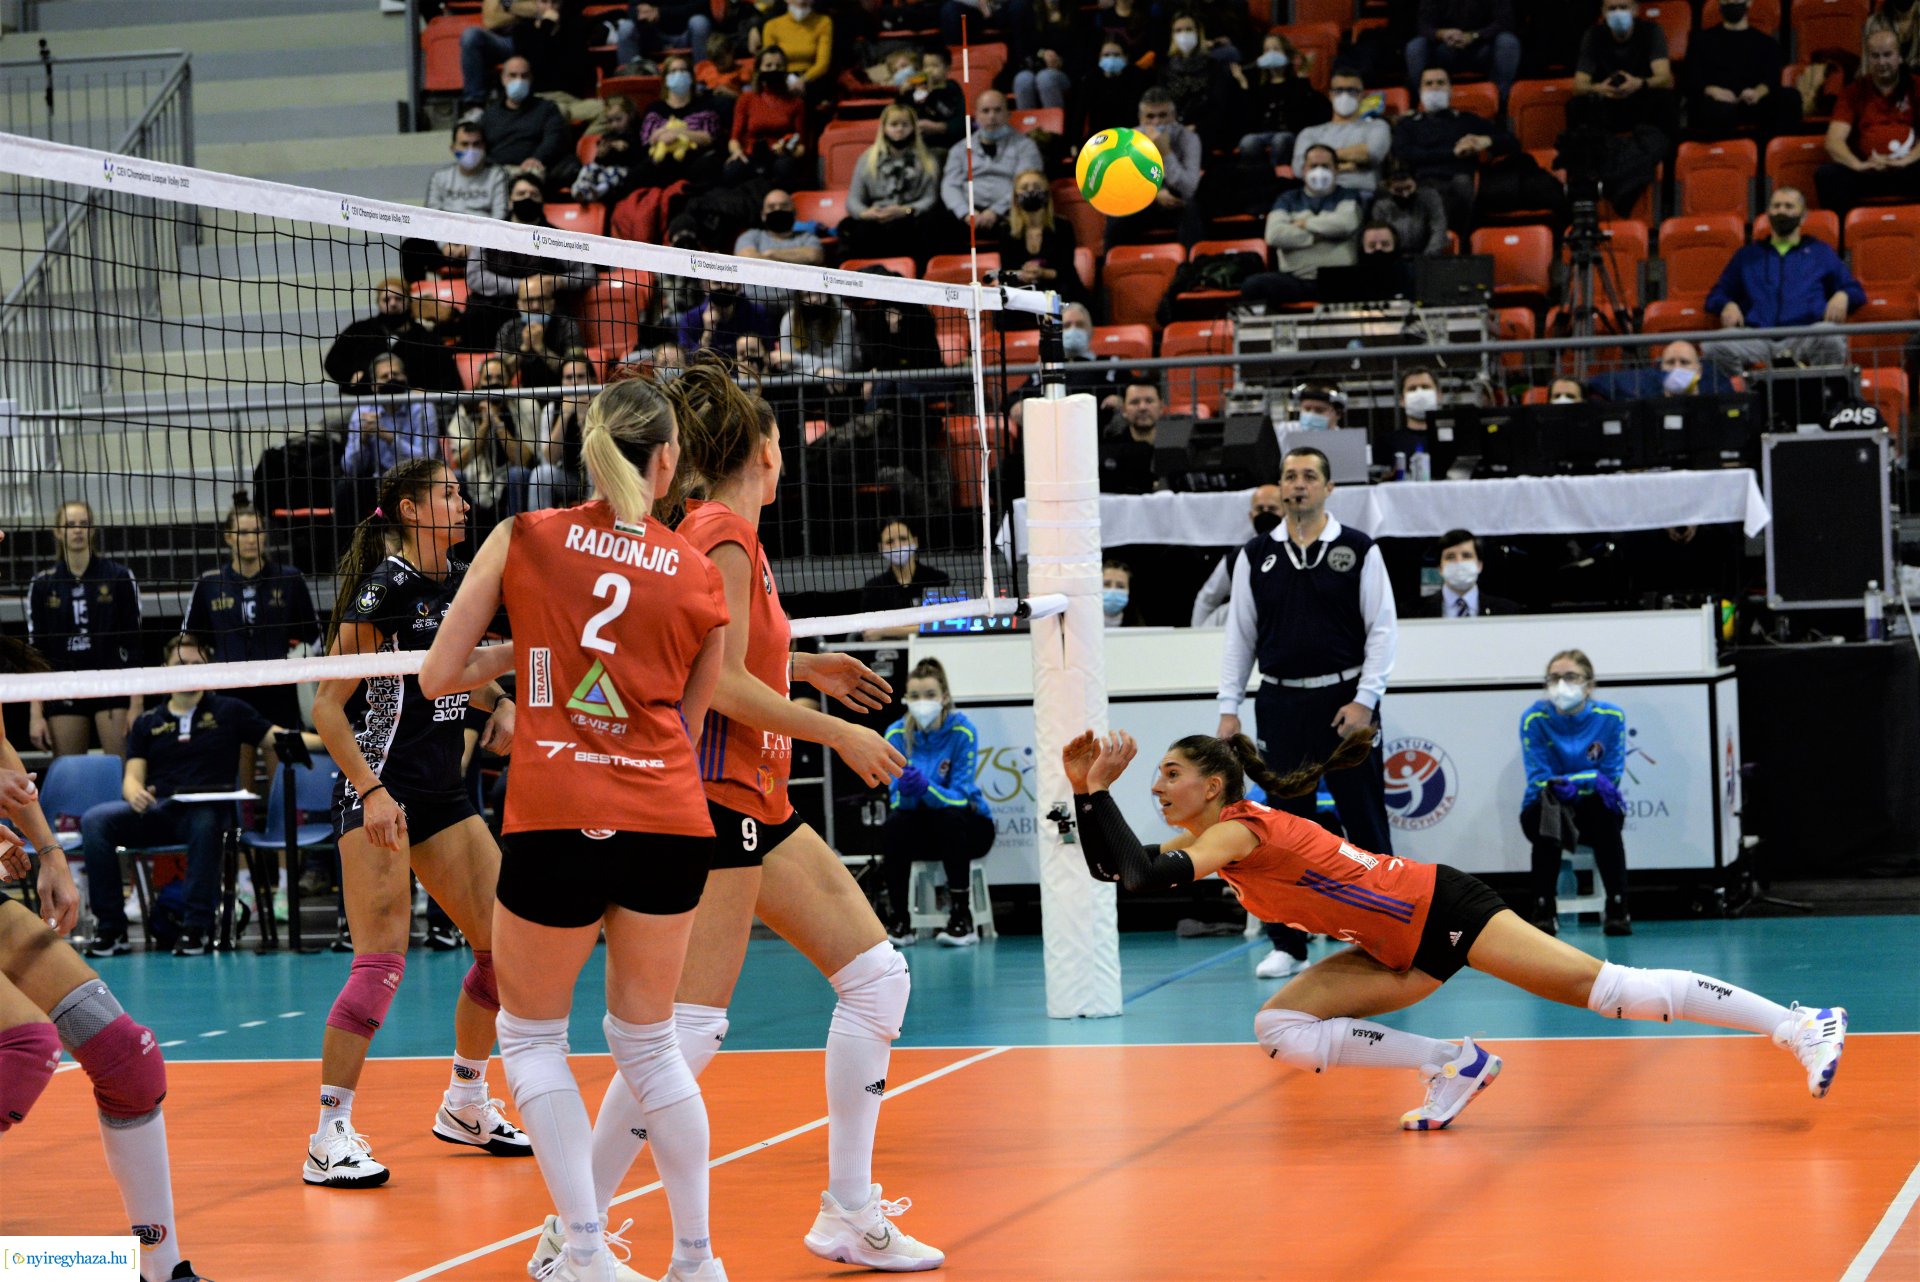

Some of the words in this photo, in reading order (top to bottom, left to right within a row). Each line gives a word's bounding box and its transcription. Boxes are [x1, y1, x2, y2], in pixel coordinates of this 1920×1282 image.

[127, 169, 151, 181] Champions
[152, 173, 167, 184] League
[359, 208, 379, 219] Champions
[580, 572, 631, 655] 2
[537, 651, 546, 704] STRABAG
[434, 693, 470, 709] GRUP
[432, 707, 467, 722] AZOT
[570, 714, 610, 732] KE-VIZ
[610, 722, 628, 734] 21
[1387, 740, 1433, 754] FATUM
[575, 752, 665, 768] BESTRONG
[741, 817, 757, 851] 9
[1697, 979, 1733, 999] MIKASA
[1352, 1027, 1385, 1045] MIKASA
